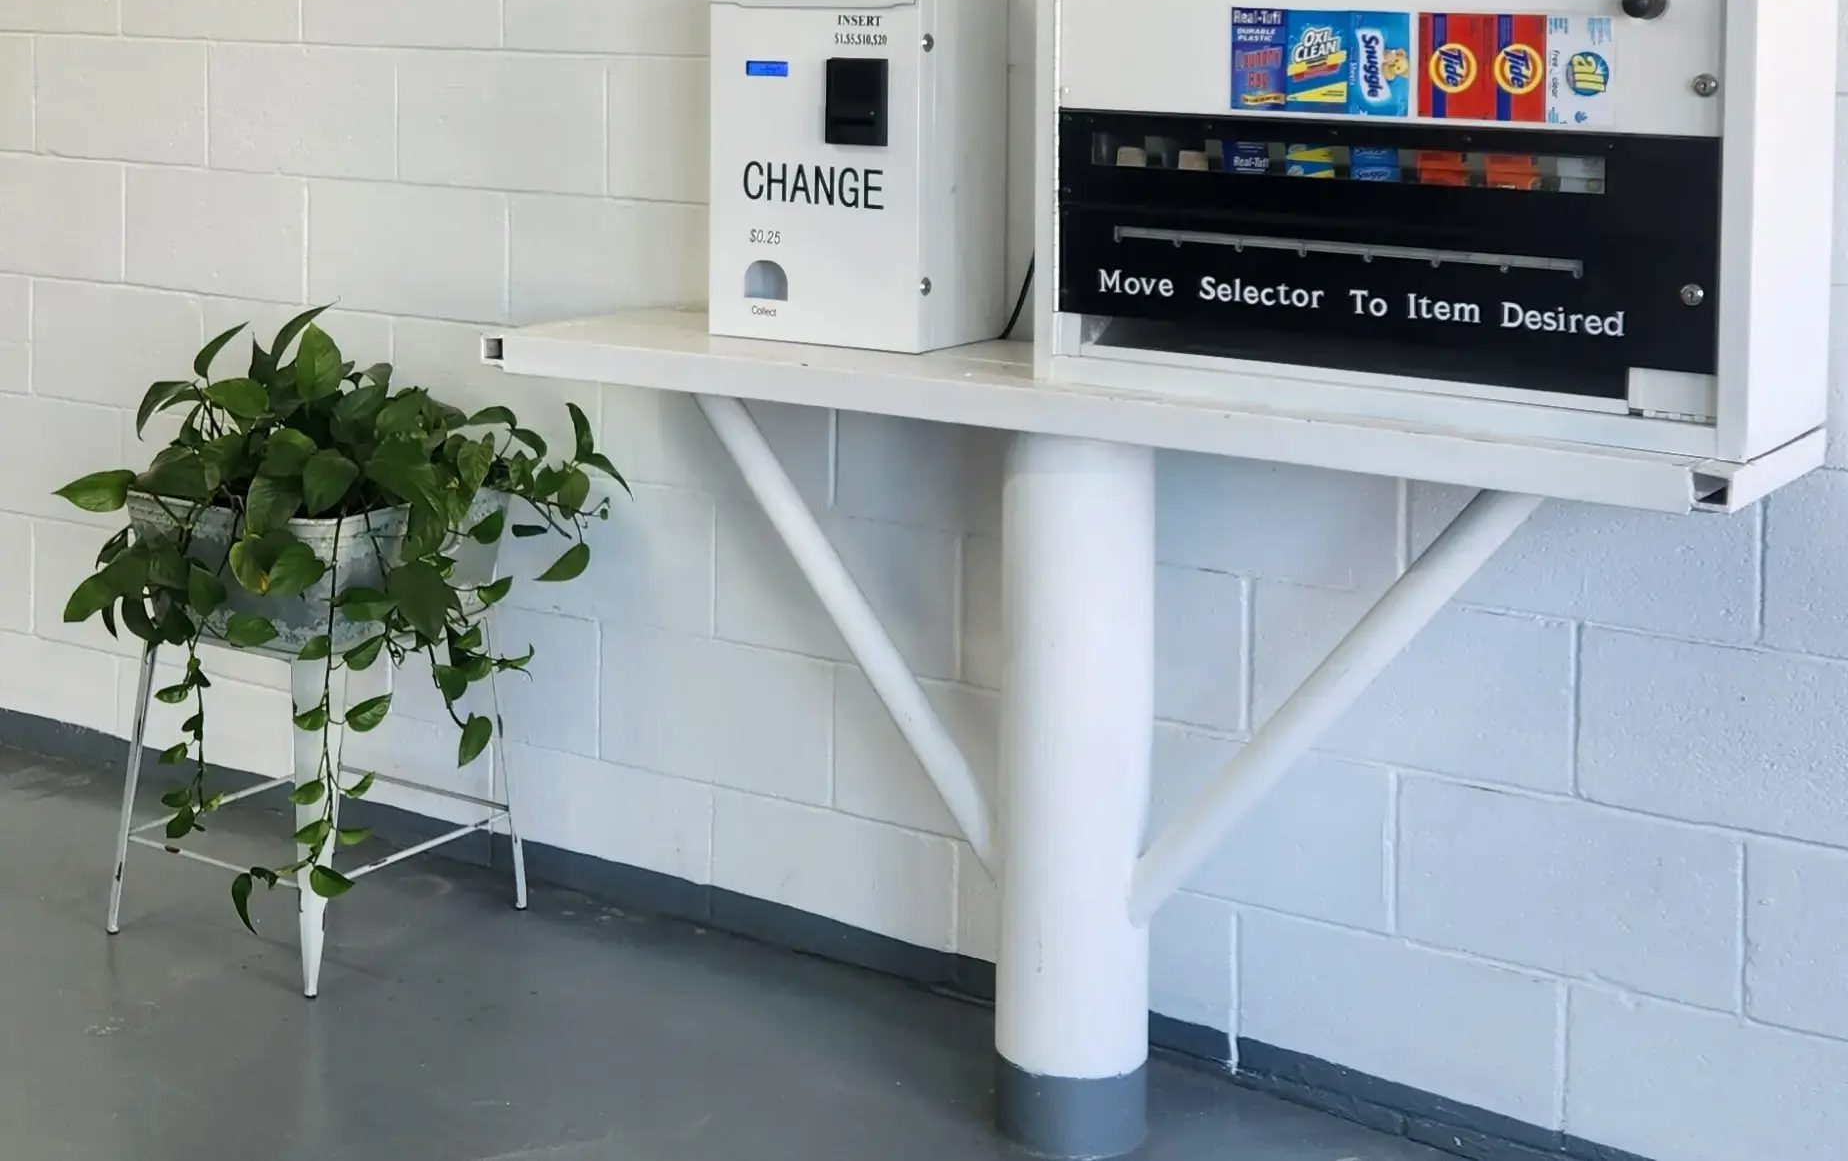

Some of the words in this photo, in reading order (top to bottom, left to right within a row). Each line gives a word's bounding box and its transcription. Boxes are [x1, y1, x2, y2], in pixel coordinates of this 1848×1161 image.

[837, 14, 882, 27] INSERT
[1303, 30, 1329, 47] OXI
[1294, 41, 1337, 63] CLEAN
[1551, 50, 1560, 67] free
[1361, 34, 1384, 98] Snuggle
[1439, 48, 1465, 88] Tide
[1503, 49, 1530, 89] Tide
[1572, 53, 1606, 92] all
[1551, 77, 1560, 99] clear
[743, 160, 885, 210] CHANGE
[749, 228, 781, 245] $0.25
[751, 305, 777, 317] Collect
[1098, 268, 1174, 297] Move
[1198, 276, 1324, 309] Selector
[1349, 288, 1388, 318] To
[1406, 293, 1481, 324] Item
[1501, 301, 1625, 337] Desired
